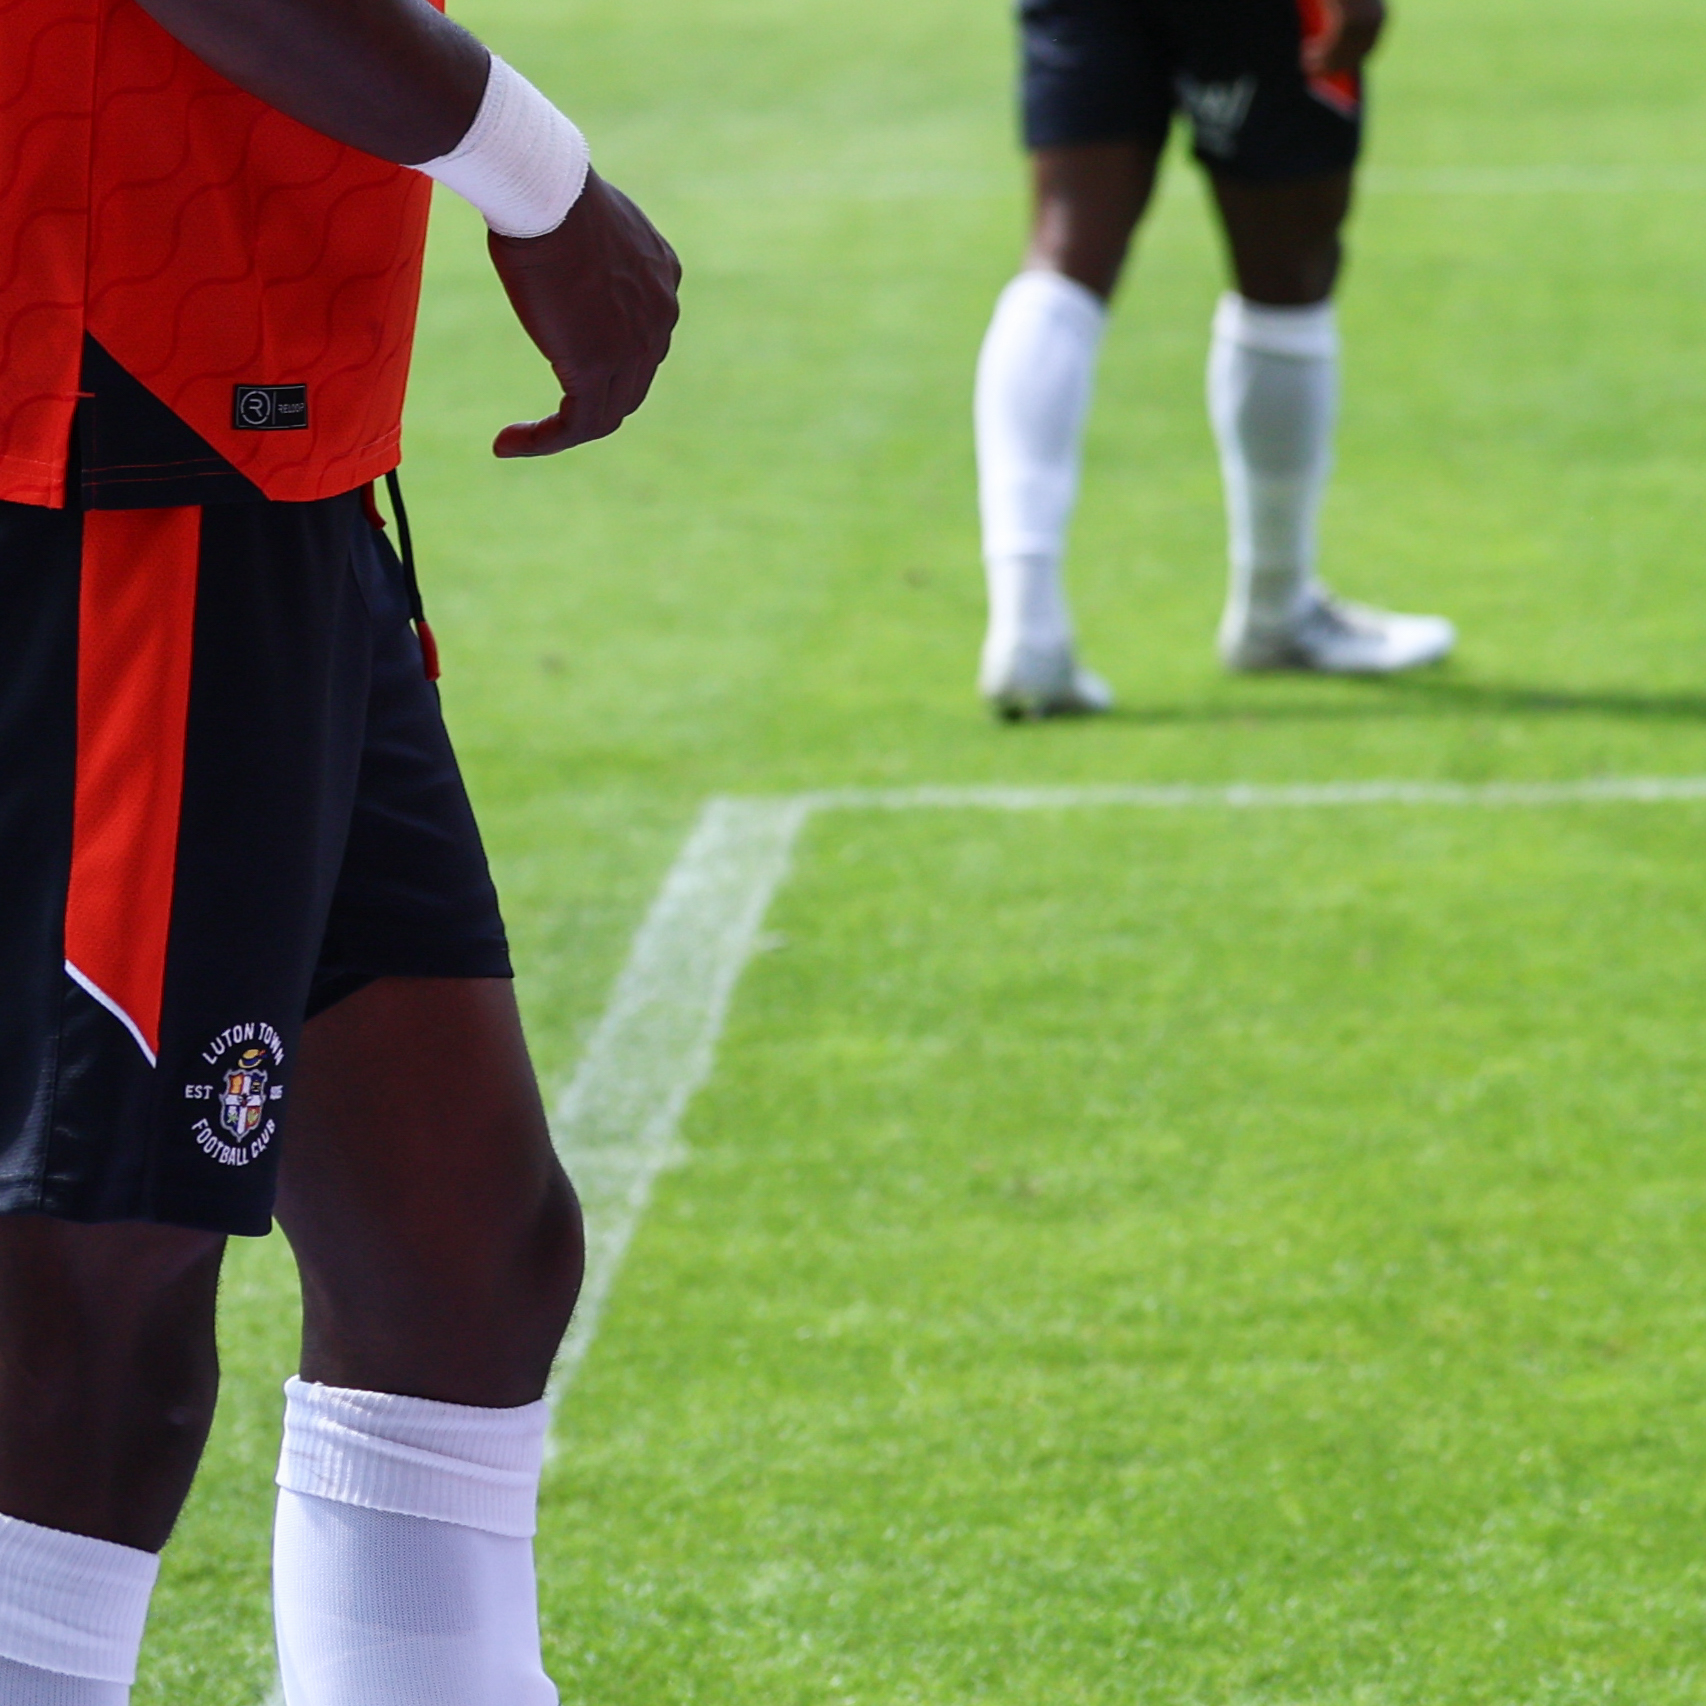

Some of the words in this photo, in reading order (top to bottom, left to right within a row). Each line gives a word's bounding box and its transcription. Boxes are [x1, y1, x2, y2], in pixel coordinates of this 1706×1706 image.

[202, 1022, 256, 1065] LUTON
[257, 1022, 285, 1066] TOWN
[184, 1084, 214, 1100] EST
[191, 1117, 250, 1167] FOOTBALL
[250, 1118, 276, 1159] CLUB
